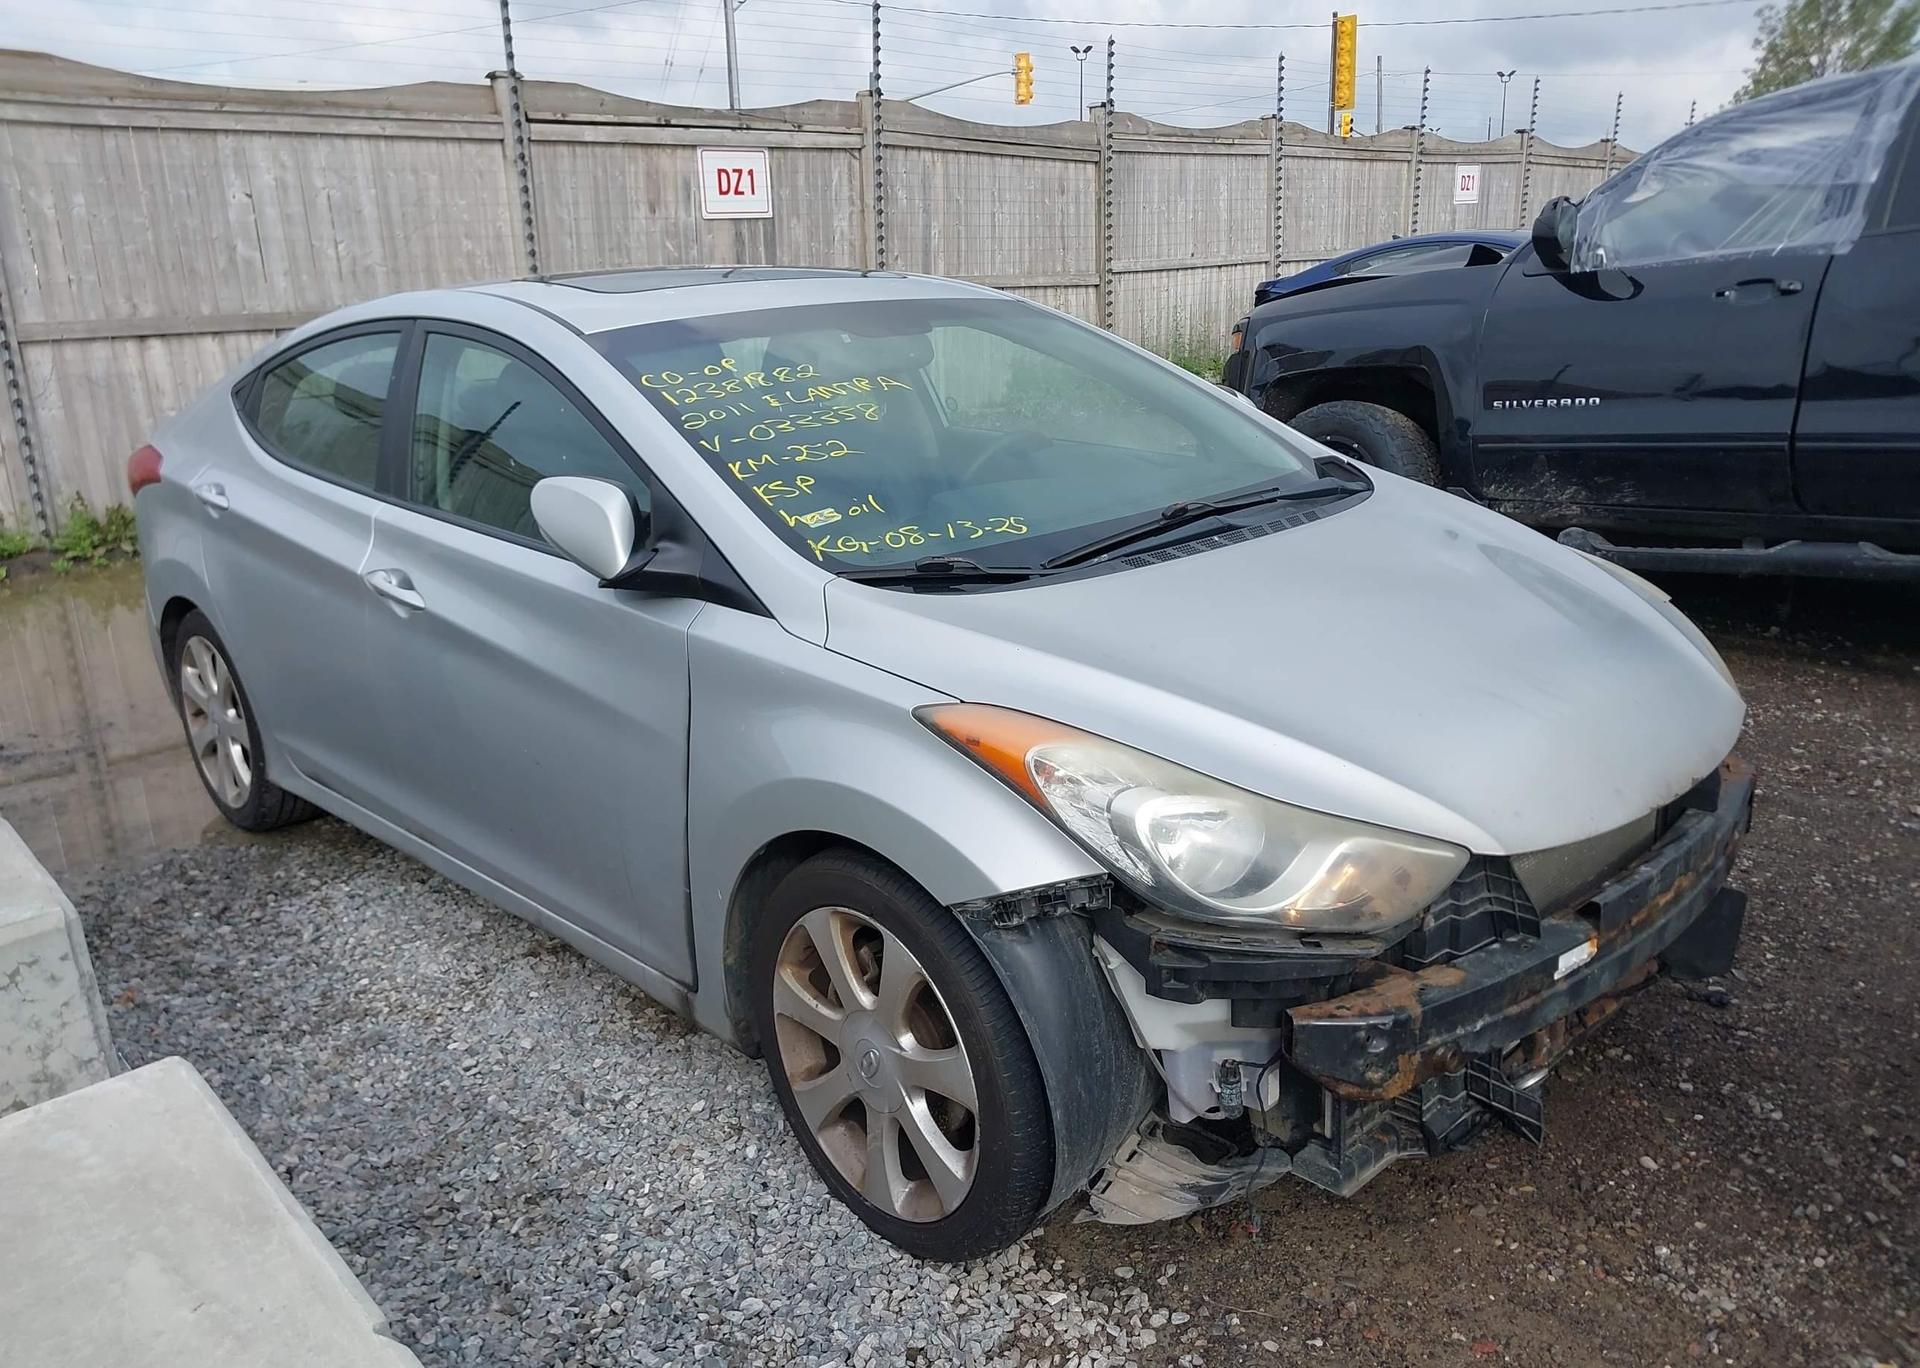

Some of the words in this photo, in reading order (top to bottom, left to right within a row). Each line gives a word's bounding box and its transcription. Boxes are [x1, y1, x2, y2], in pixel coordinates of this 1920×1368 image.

[717, 168, 756, 196] DZ1
[1460, 174, 1475, 192] DZ1
[641, 357, 739, 389] CO-OP
[681, 402, 756, 430] 2011
[761, 375, 914, 408] ELANTRA
[1493, 397, 1601, 410] SILVERADO
[727, 439, 866, 481] KM-252
[752, 475, 816, 507] KSP
[848, 493, 886, 516] oil
